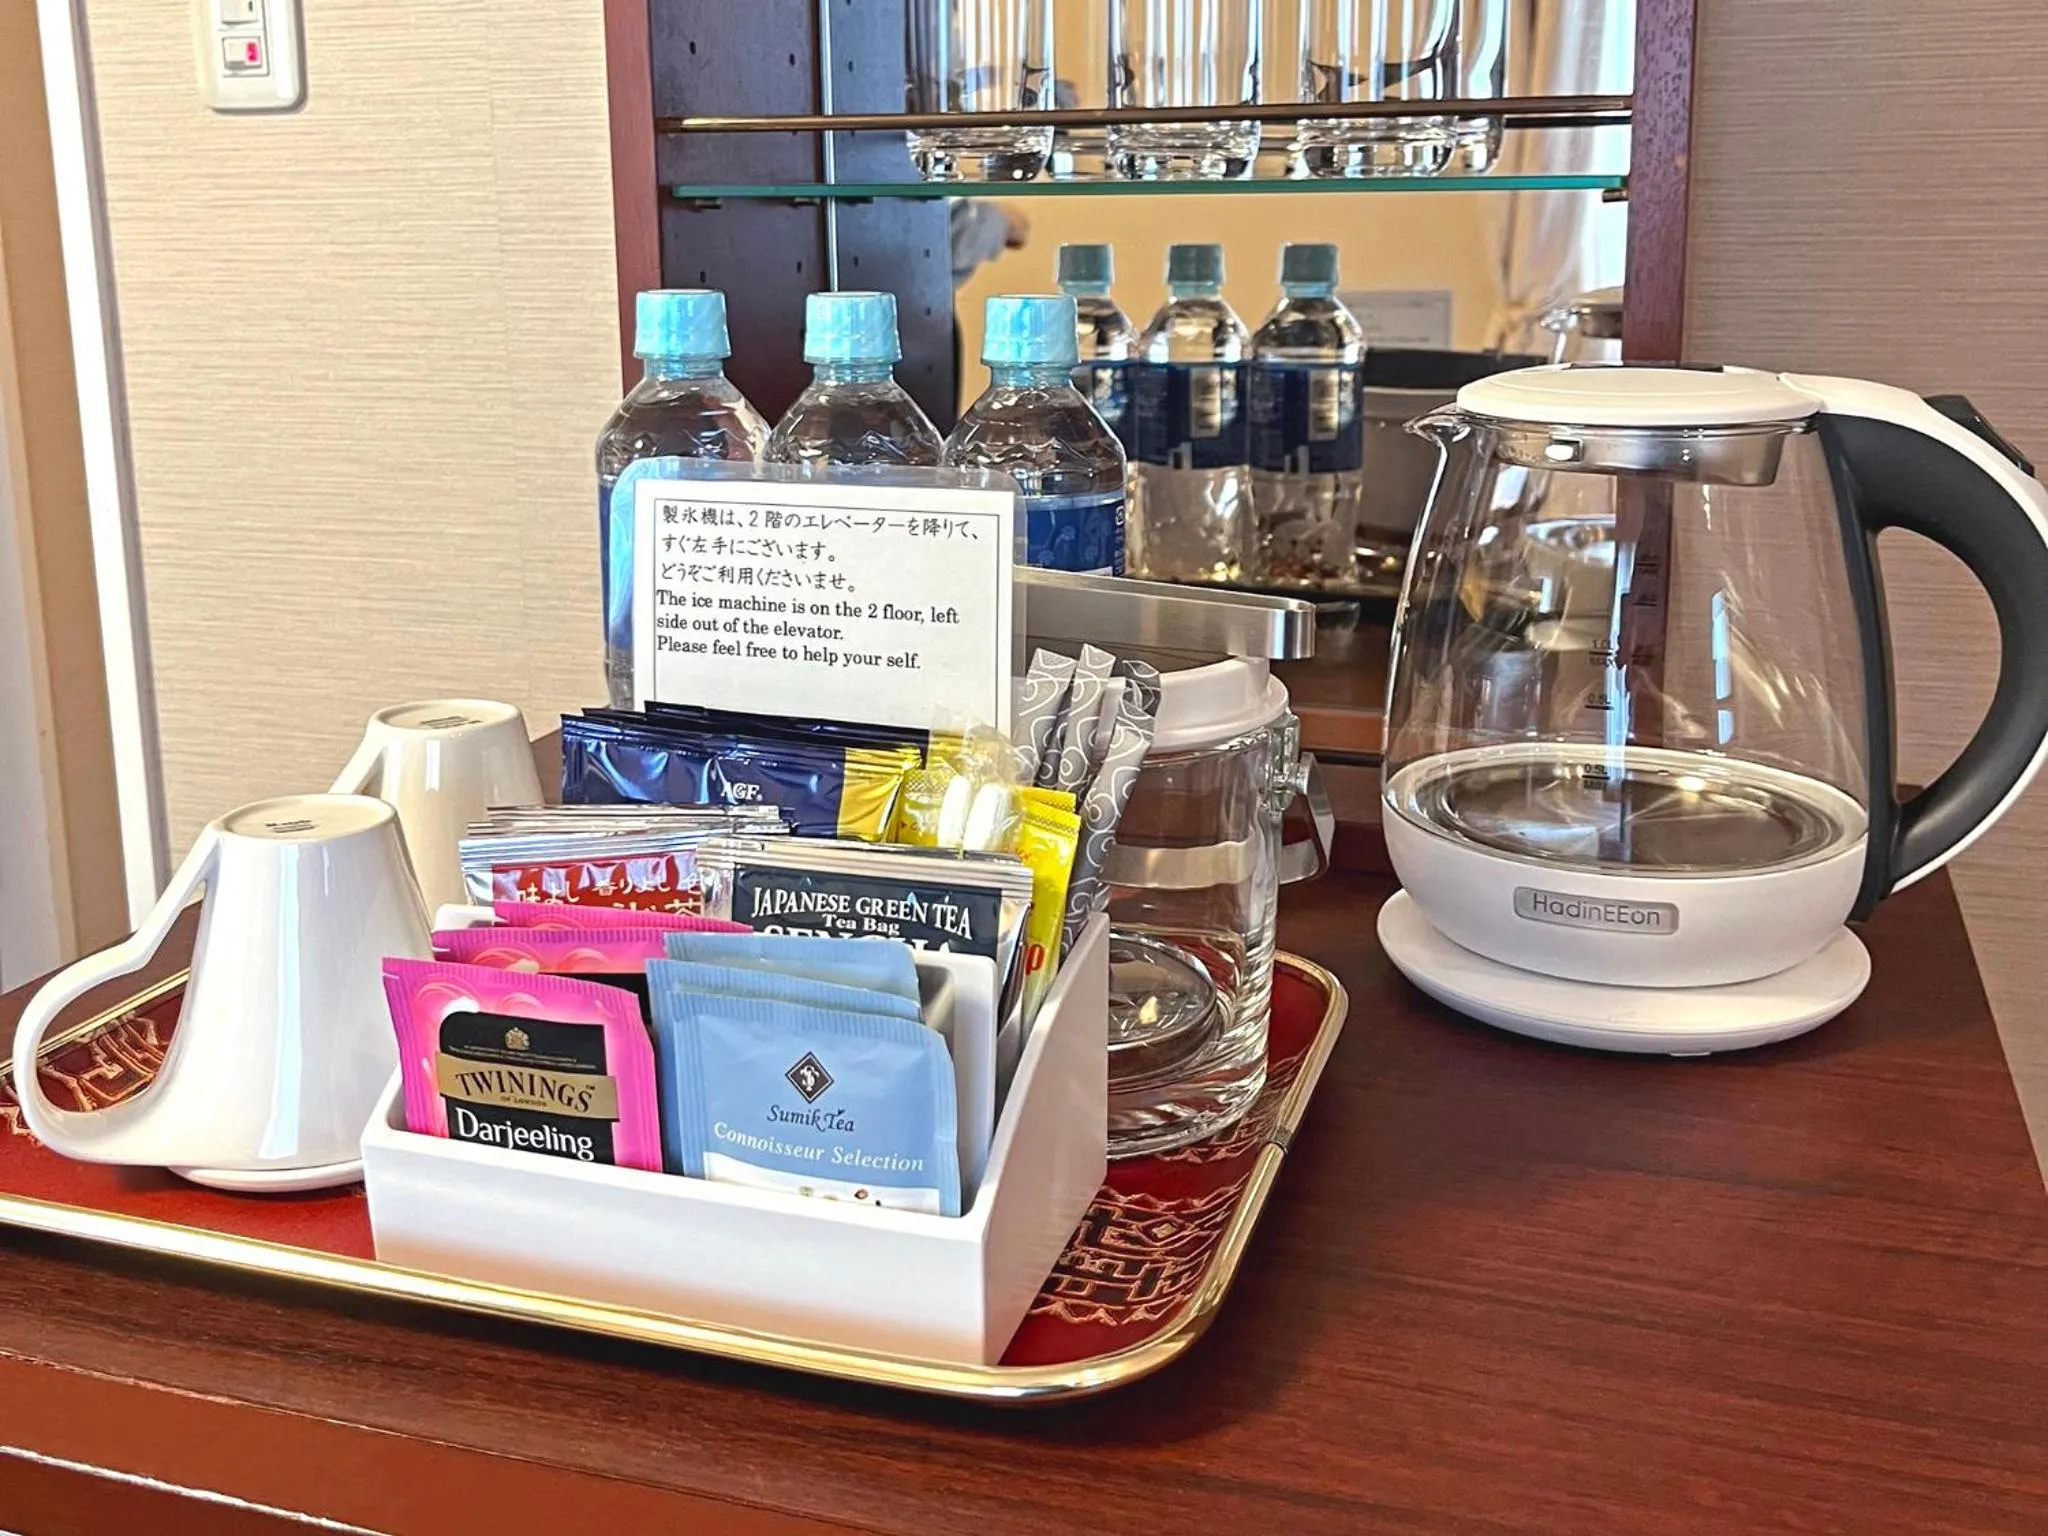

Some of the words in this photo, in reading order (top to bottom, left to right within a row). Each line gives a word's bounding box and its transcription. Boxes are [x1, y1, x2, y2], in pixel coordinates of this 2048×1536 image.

[661, 533, 836, 563] すぐ左手にございます。
[661, 562, 856, 593] どうぞご利用くださいませ。
[656, 589, 687, 606] The
[692, 592, 713, 608] ice
[718, 595, 787, 613] machine
[791, 598, 805, 614] is
[810, 603, 830, 616] on
[835, 601, 862, 618] the
[868, 603, 878, 619] 2
[883, 603, 925, 624] floor,
[931, 606, 960, 624] left
[656, 613, 688, 629] side
[692, 618, 719, 632] out
[723, 617, 740, 633] of
[743, 618, 769, 635] the
[773, 621, 844, 640] elevator.
[657, 635, 708, 654] Please
[712, 639, 742, 657] feel
[746, 641, 777, 658] free
[782, 645, 798, 660] to
[803, 646, 838, 667] help
[843, 653, 882, 668] your
[886, 652, 921, 669] self.
[752, 886, 850, 918] JAPANESE
[855, 896, 928, 925] GREEN
[1532, 892, 1661, 926] HadinEEon
[822, 913, 856, 929] Tea
[863, 917, 900, 936] Bag
[455, 1106, 595, 1162] Darjeeling
[713, 1121, 825, 1161] Connoisseur
[831, 1145, 924, 1172] Selection
